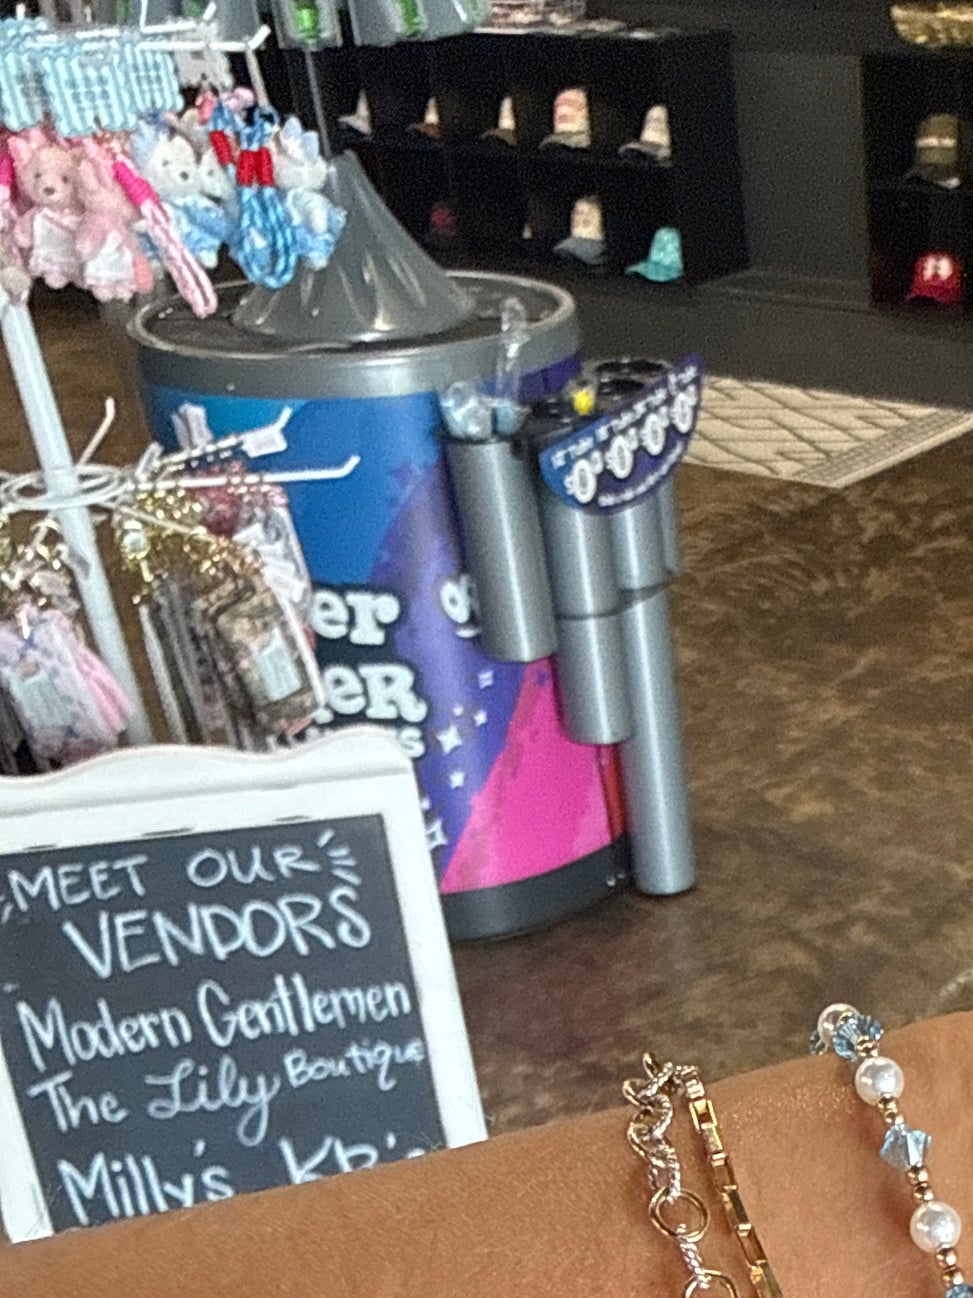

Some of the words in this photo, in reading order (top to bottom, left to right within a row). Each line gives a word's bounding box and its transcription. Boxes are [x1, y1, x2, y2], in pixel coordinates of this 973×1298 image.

[8, 854, 149, 910] MEET
[186, 842, 320, 887] OUR
[62, 886, 371, 979] VENDORS
[16, 998, 193, 1072] Modern
[199, 973, 411, 1047] Gentlemen
[26, 1070, 128, 1133] The
[144, 1057, 281, 1146] Lily
[283, 1038, 425, 1092] Boutique
[57, 1138, 235, 1226] Milly's
